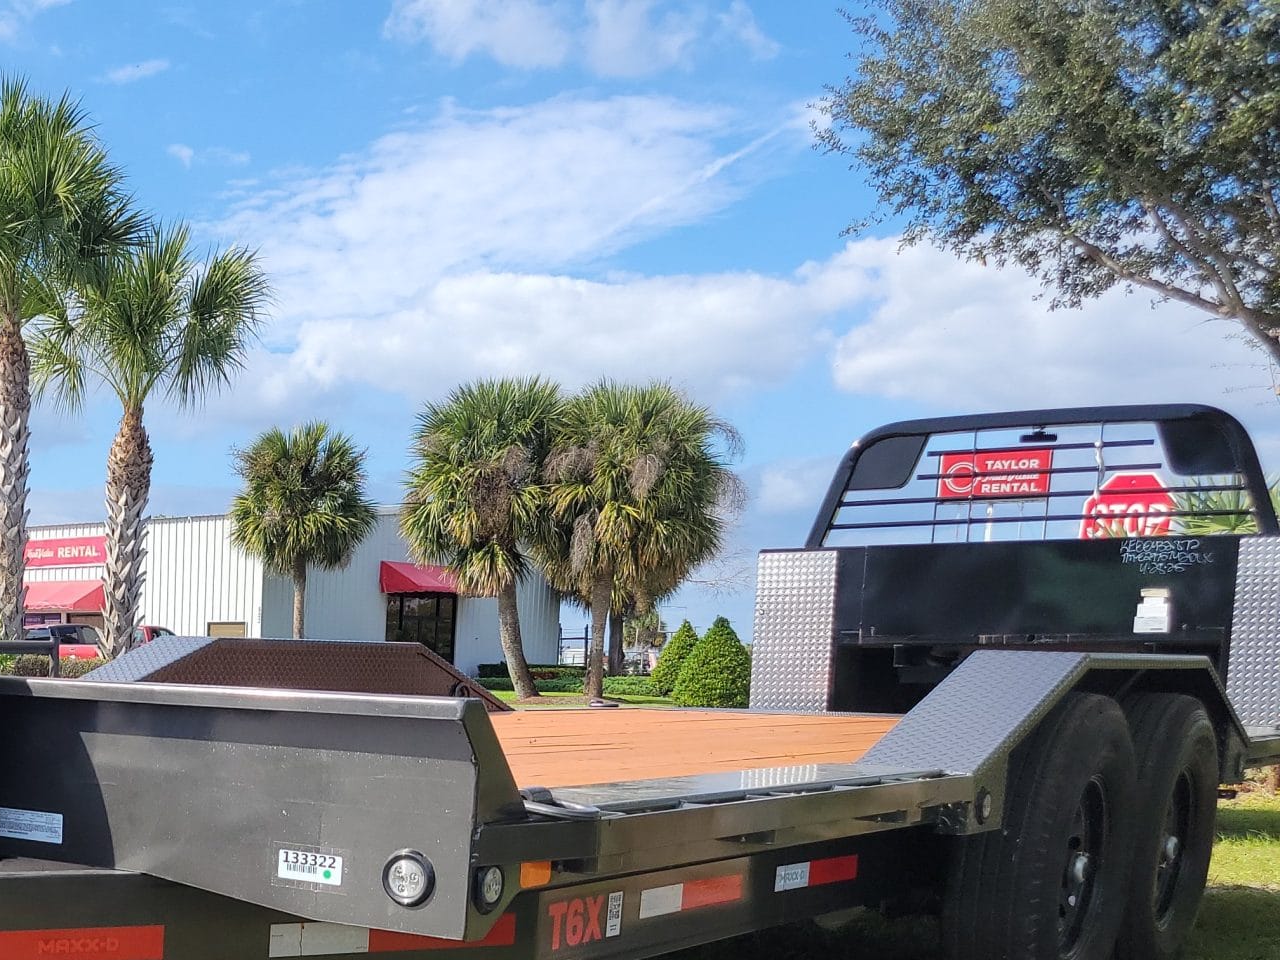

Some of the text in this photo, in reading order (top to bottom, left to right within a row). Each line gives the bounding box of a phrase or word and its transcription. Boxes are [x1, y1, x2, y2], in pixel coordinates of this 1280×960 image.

[985, 459, 1040, 470] TAYLOR
[981, 482, 1039, 493] RENTAL
[1087, 503, 1169, 538] STOP
[58, 546, 99, 558] RENTAL
[283, 850, 337, 869] 133322
[549, 895, 605, 950] T6X
[37, 937, 119, 955] MAXX-D
